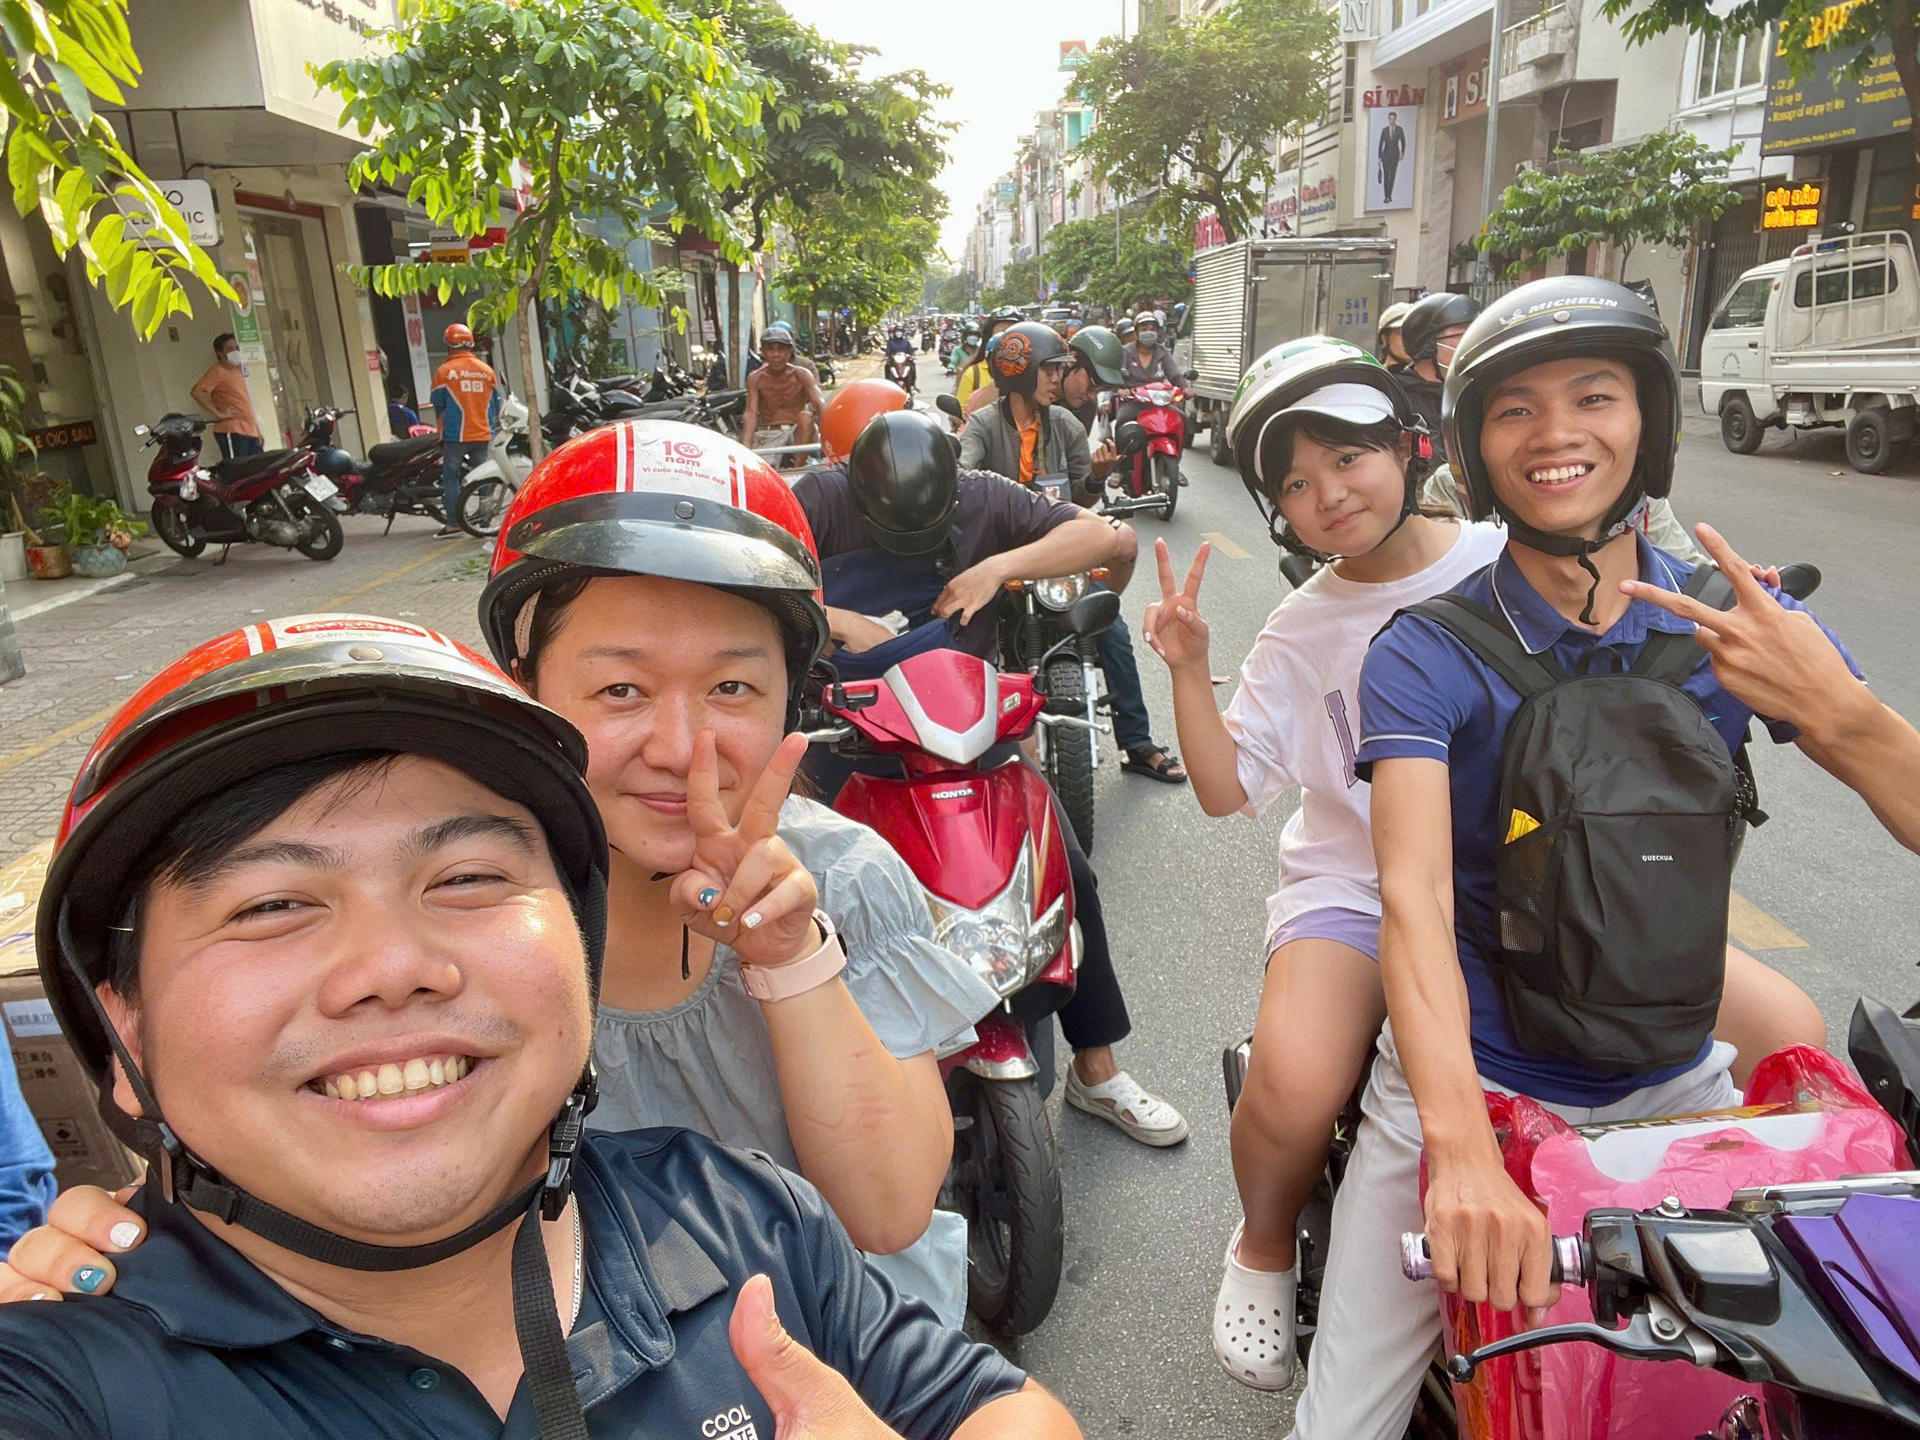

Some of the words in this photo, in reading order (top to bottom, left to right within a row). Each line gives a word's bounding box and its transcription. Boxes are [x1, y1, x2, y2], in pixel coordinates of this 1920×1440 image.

[1387, 84, 1426, 105] TÂN
[1529, 296, 1618, 314] MICHELIN
[932, 788, 975, 799] HONDA
[1641, 854, 1674, 862] QUECHUA
[702, 1404, 752, 1438] COOL
